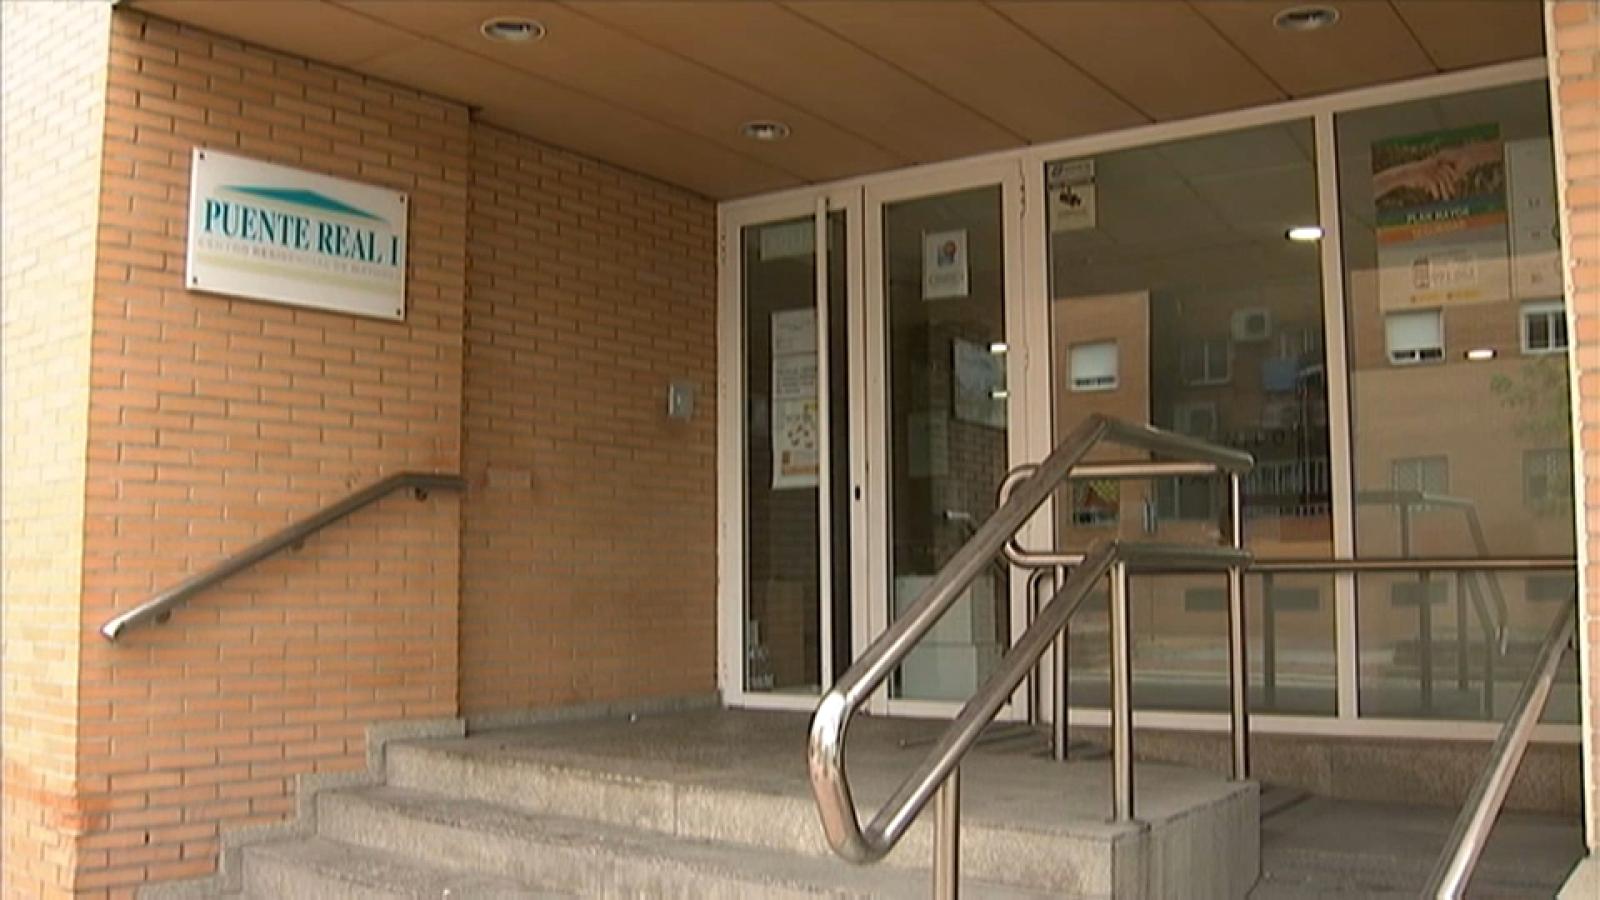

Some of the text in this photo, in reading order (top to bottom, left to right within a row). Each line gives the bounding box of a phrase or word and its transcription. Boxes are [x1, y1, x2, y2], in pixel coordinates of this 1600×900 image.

[204, 198, 399, 267] PUENTE REAL I
